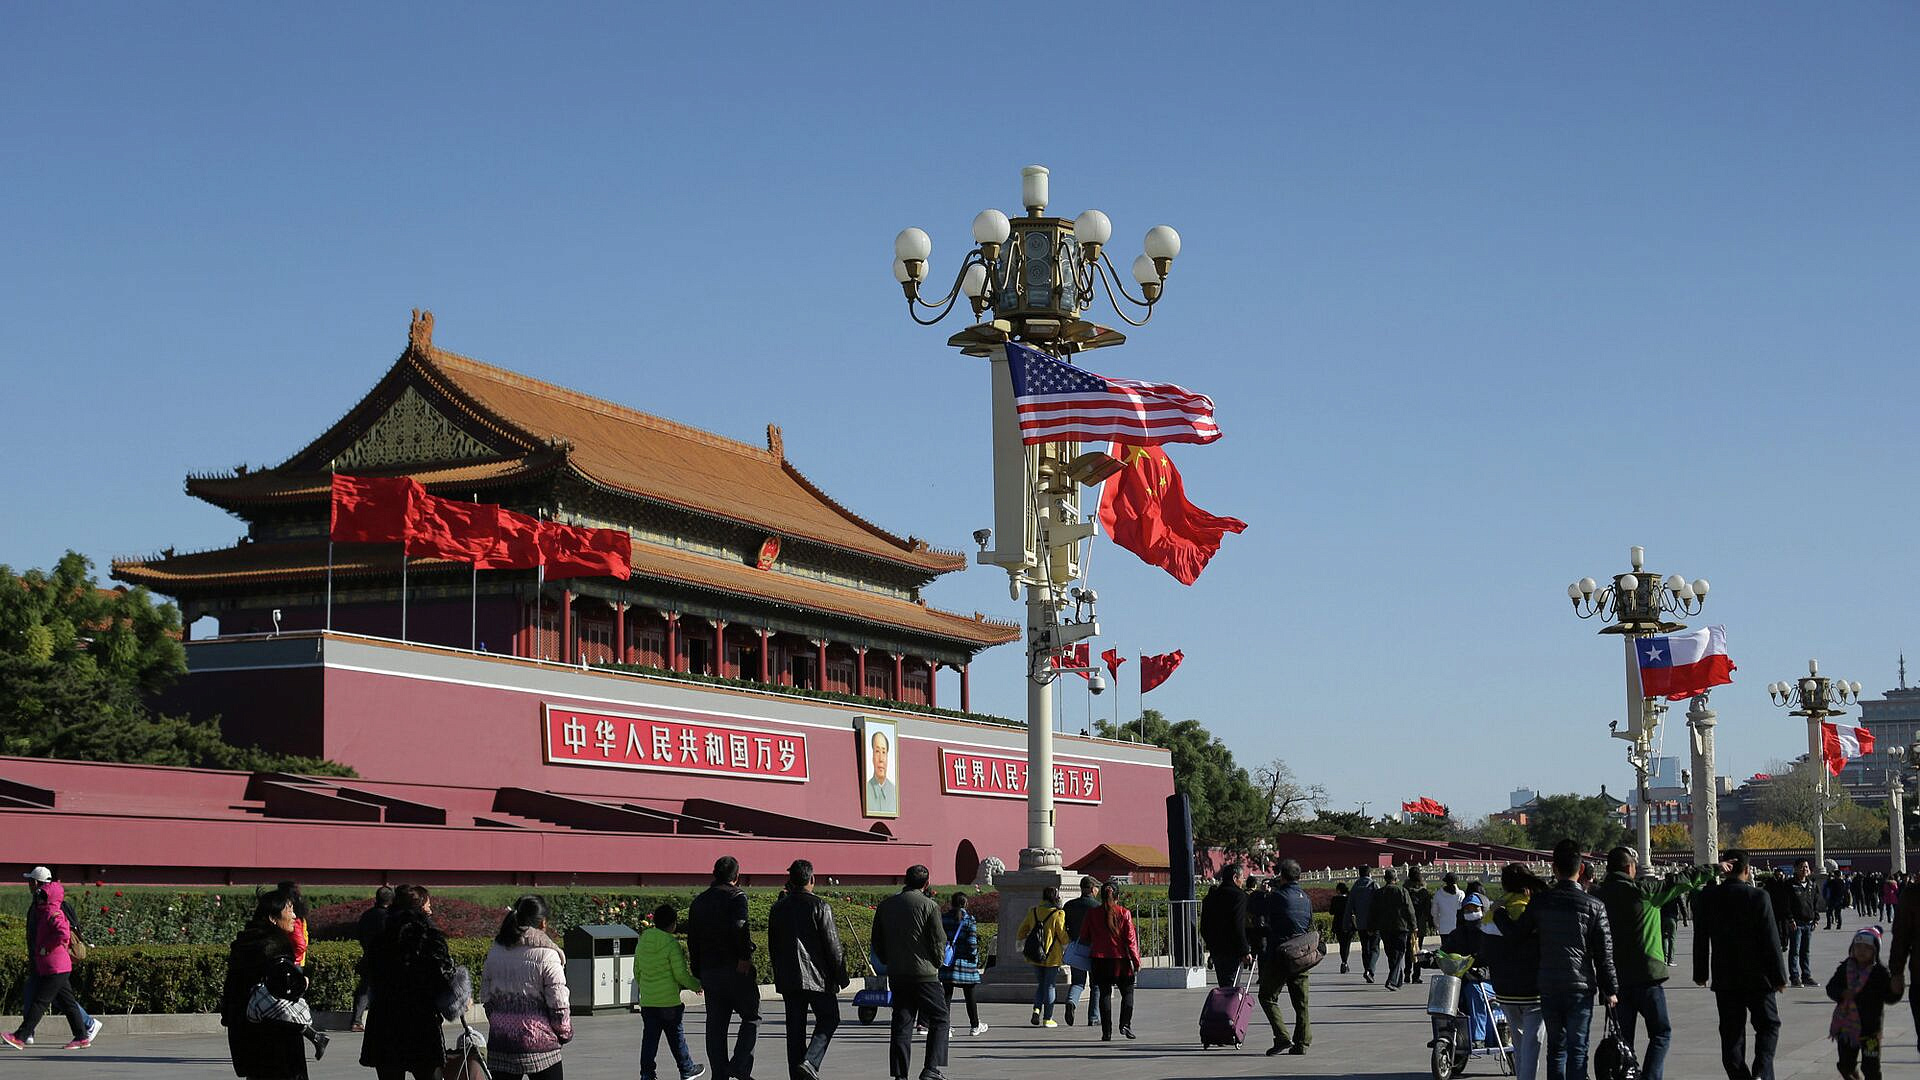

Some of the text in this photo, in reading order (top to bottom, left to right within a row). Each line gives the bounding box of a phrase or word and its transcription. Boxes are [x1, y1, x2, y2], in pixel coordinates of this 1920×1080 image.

[563, 717, 796, 772] 中华人民共和国万岁
[954, 758, 1094, 797] 世界人民大结万岁
